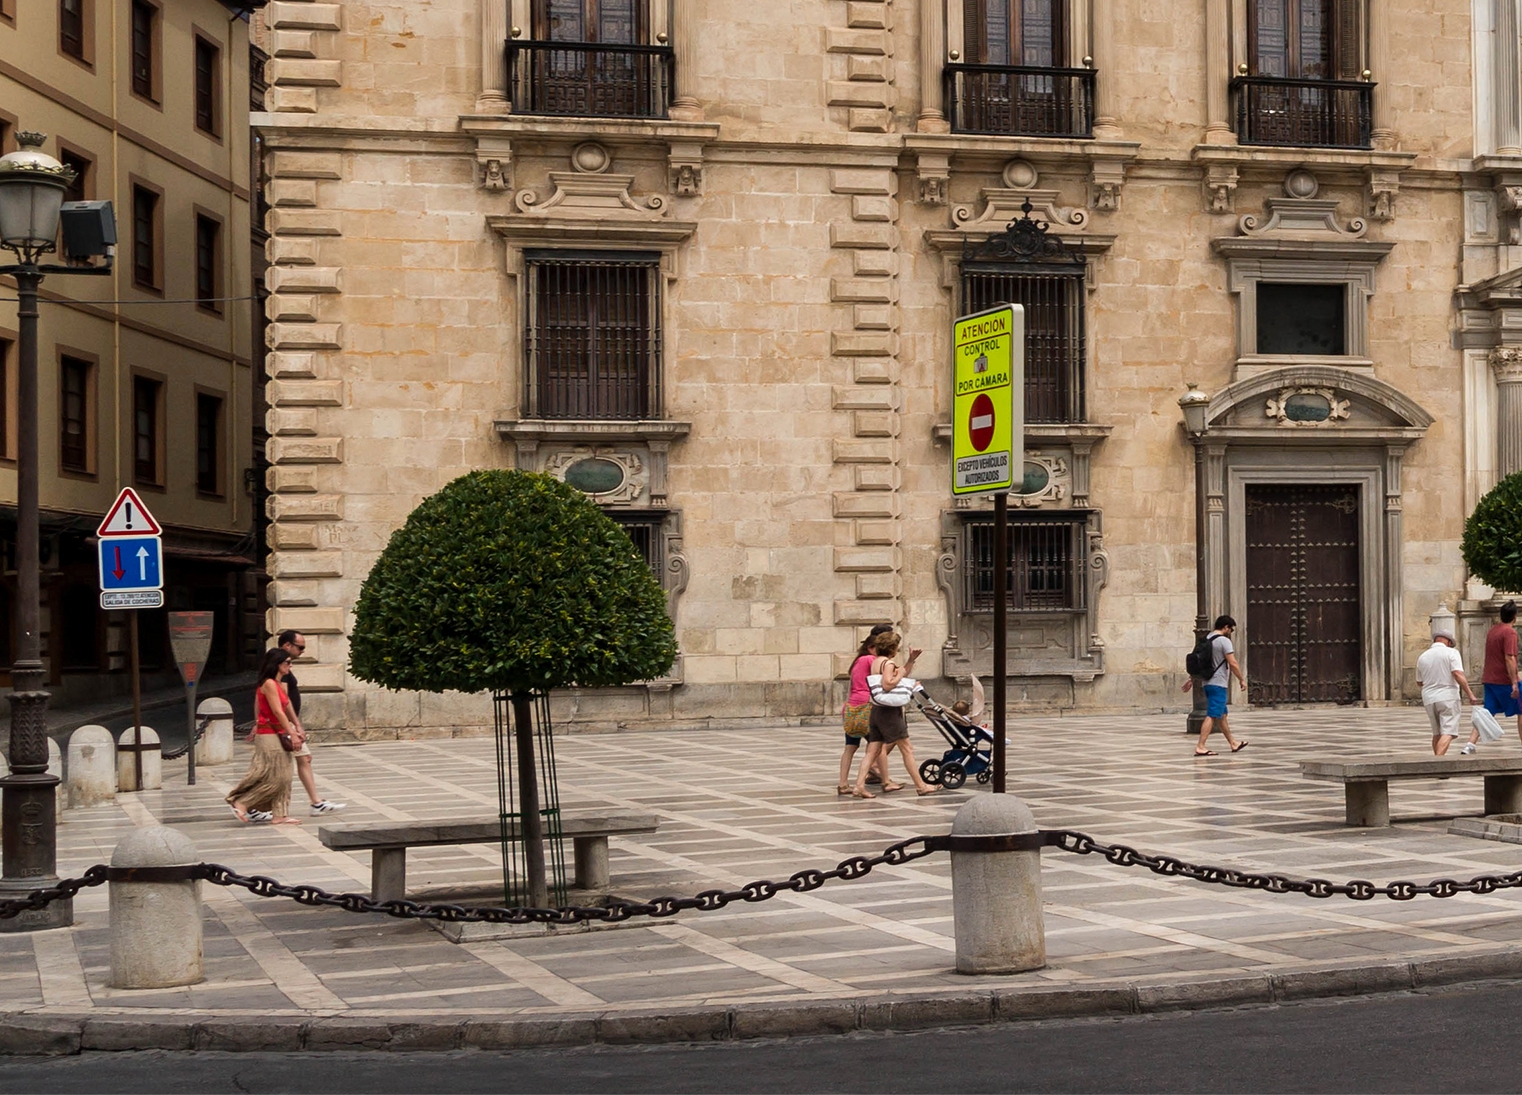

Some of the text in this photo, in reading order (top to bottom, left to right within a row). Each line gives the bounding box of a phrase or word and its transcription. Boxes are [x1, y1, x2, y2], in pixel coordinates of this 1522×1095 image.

[962, 316, 1005, 340] ATENCIÓN
[964, 339, 1000, 356] CONTROL
[958, 379, 974, 392] POR
[958, 455, 1008, 472] EXCEPTO VEHÍCULOS
[964, 470, 1000, 485] AUTORIZADOS
